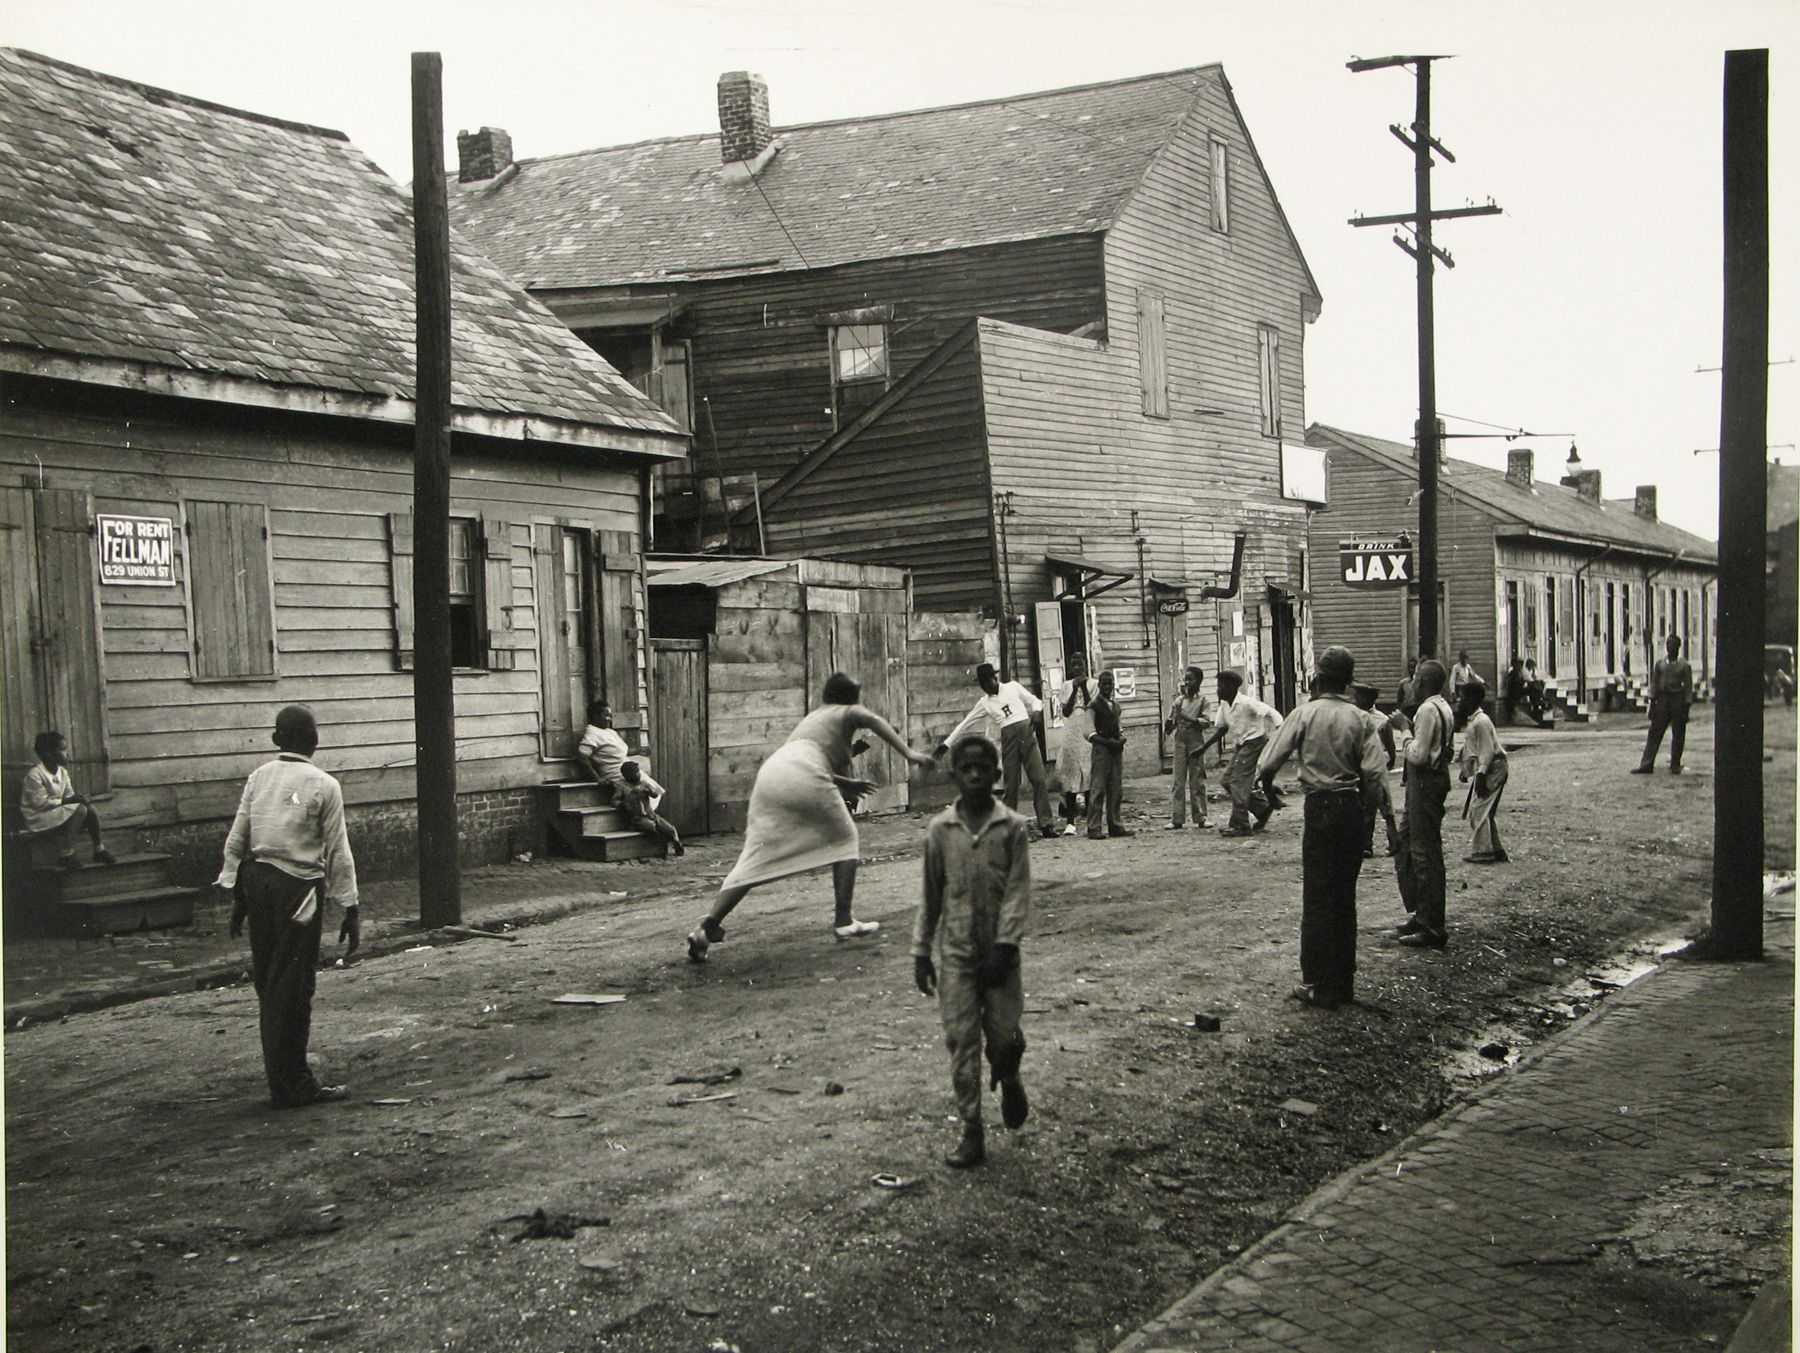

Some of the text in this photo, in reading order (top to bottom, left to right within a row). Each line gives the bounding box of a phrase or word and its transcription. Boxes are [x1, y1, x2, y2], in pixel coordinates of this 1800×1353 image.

[103, 520, 169, 541] FOR RENT
[103, 531, 169, 565] FELLMAN
[104, 564, 169, 577] 829 UNION ST
[1345, 554, 1408, 581] JAX
